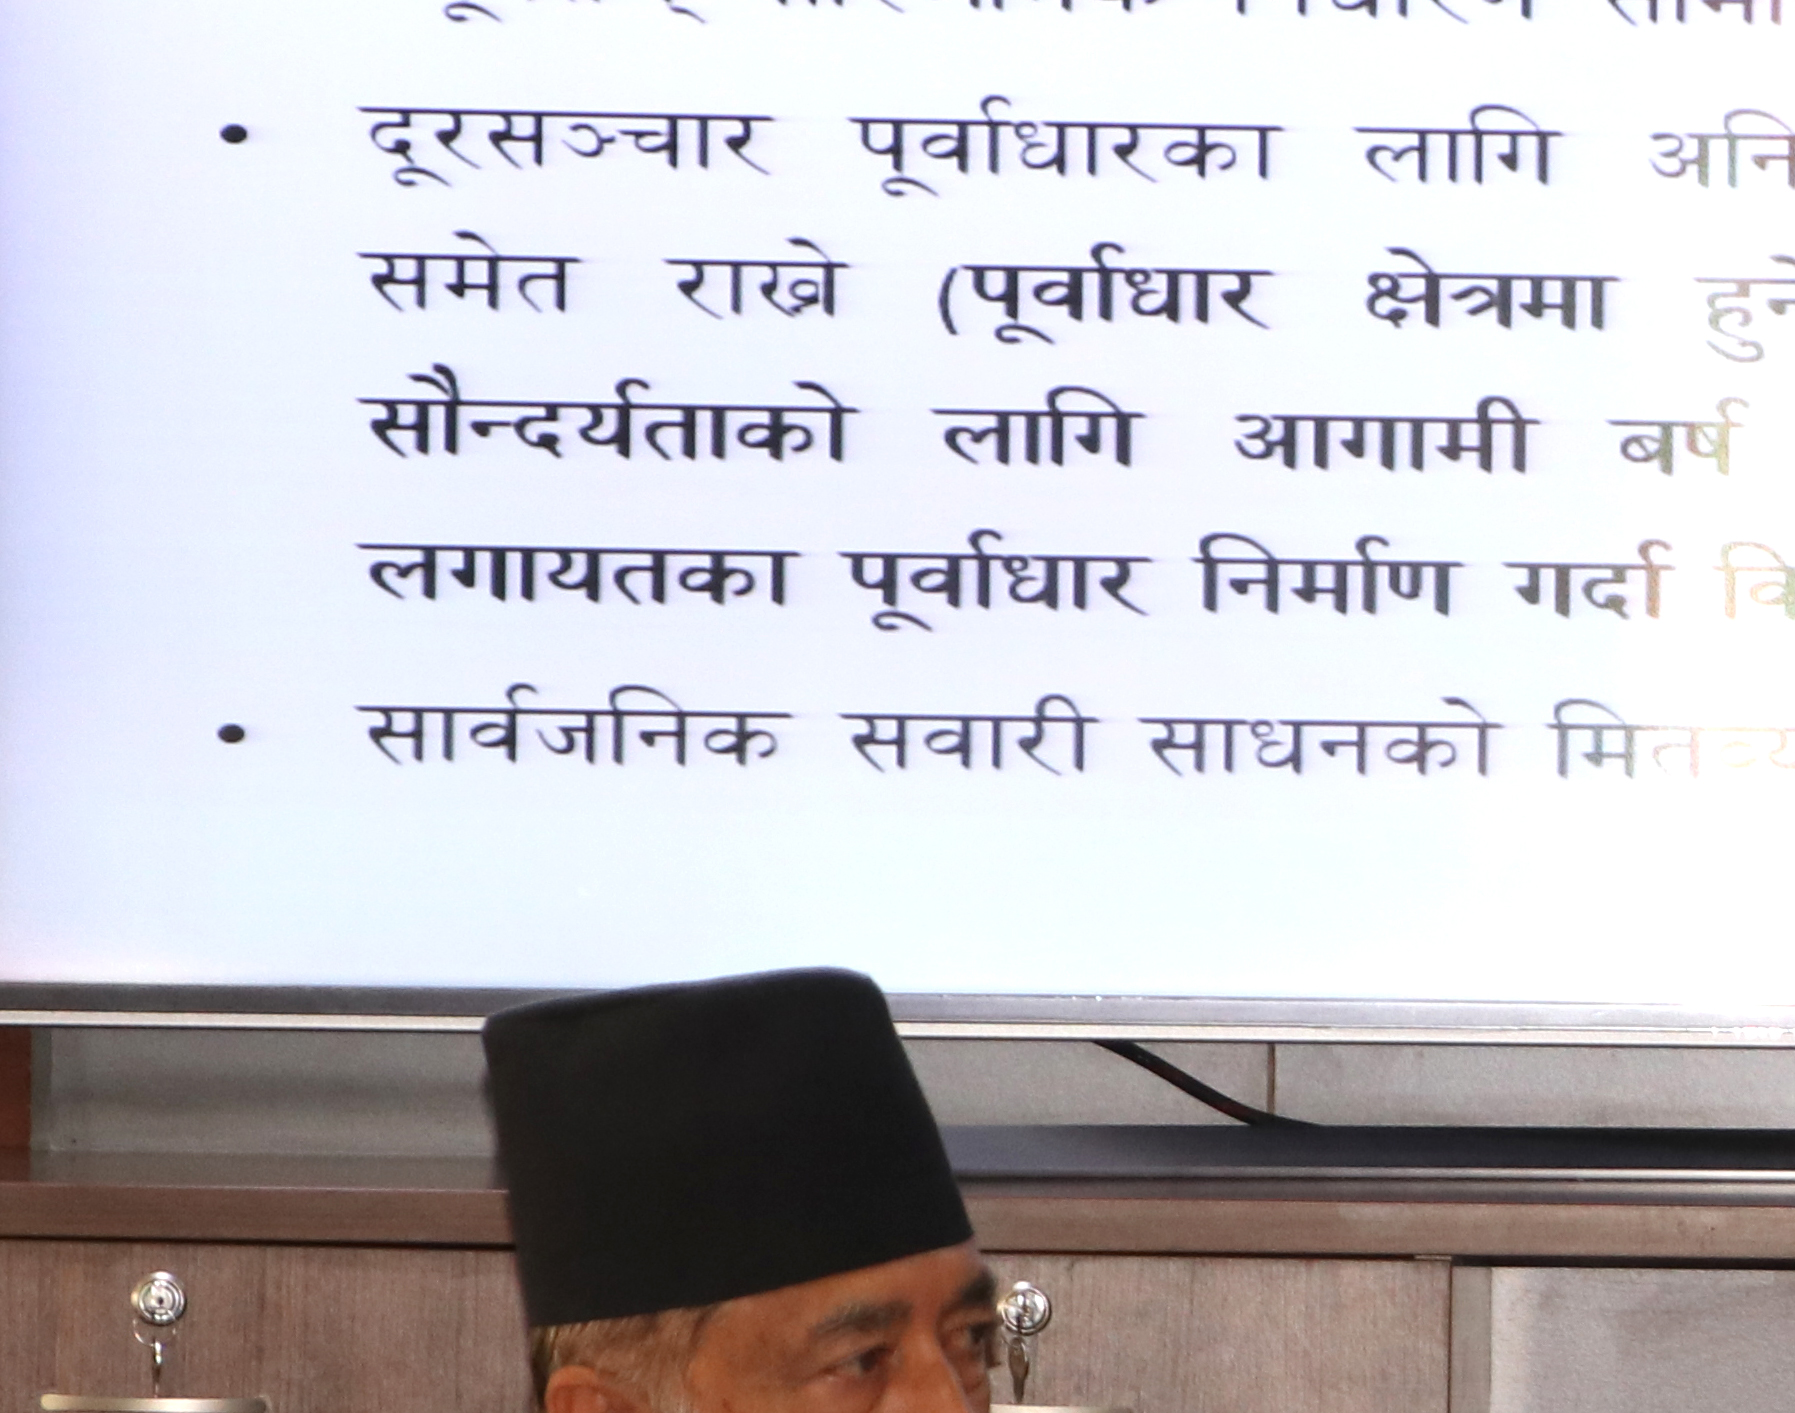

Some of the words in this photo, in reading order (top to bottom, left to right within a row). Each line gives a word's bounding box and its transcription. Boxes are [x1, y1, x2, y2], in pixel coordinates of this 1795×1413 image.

[356, 106, 777, 188] दूरसञ्चार
[847, 94, 1286, 198] पूर्वाधारका
[1353, 104, 1566, 186] लागि
[356, 229, 585, 313] समेत
[937, 241, 1276, 345] (पूर्वाधार
[1365, 246, 1622, 331] क्षेत्रमा
[355, 362, 862, 463] सौन्दर्यताको
[929, 385, 1148, 468] लागि
[1234, 395, 1543, 475] आगामी
[1606, 397, 1749, 476] बर्ष
[354, 543, 805, 607] लगायतका
[836, 528, 1156, 633] पूर्वाधार
[1190, 532, 1467, 617] निर्माण
[1502, 539, 1675, 620] गर्दा
[353, 682, 795, 768] सार्वजनिक
[838, 693, 1103, 776] सवारी
[1137, 696, 1506, 777] साधनको
